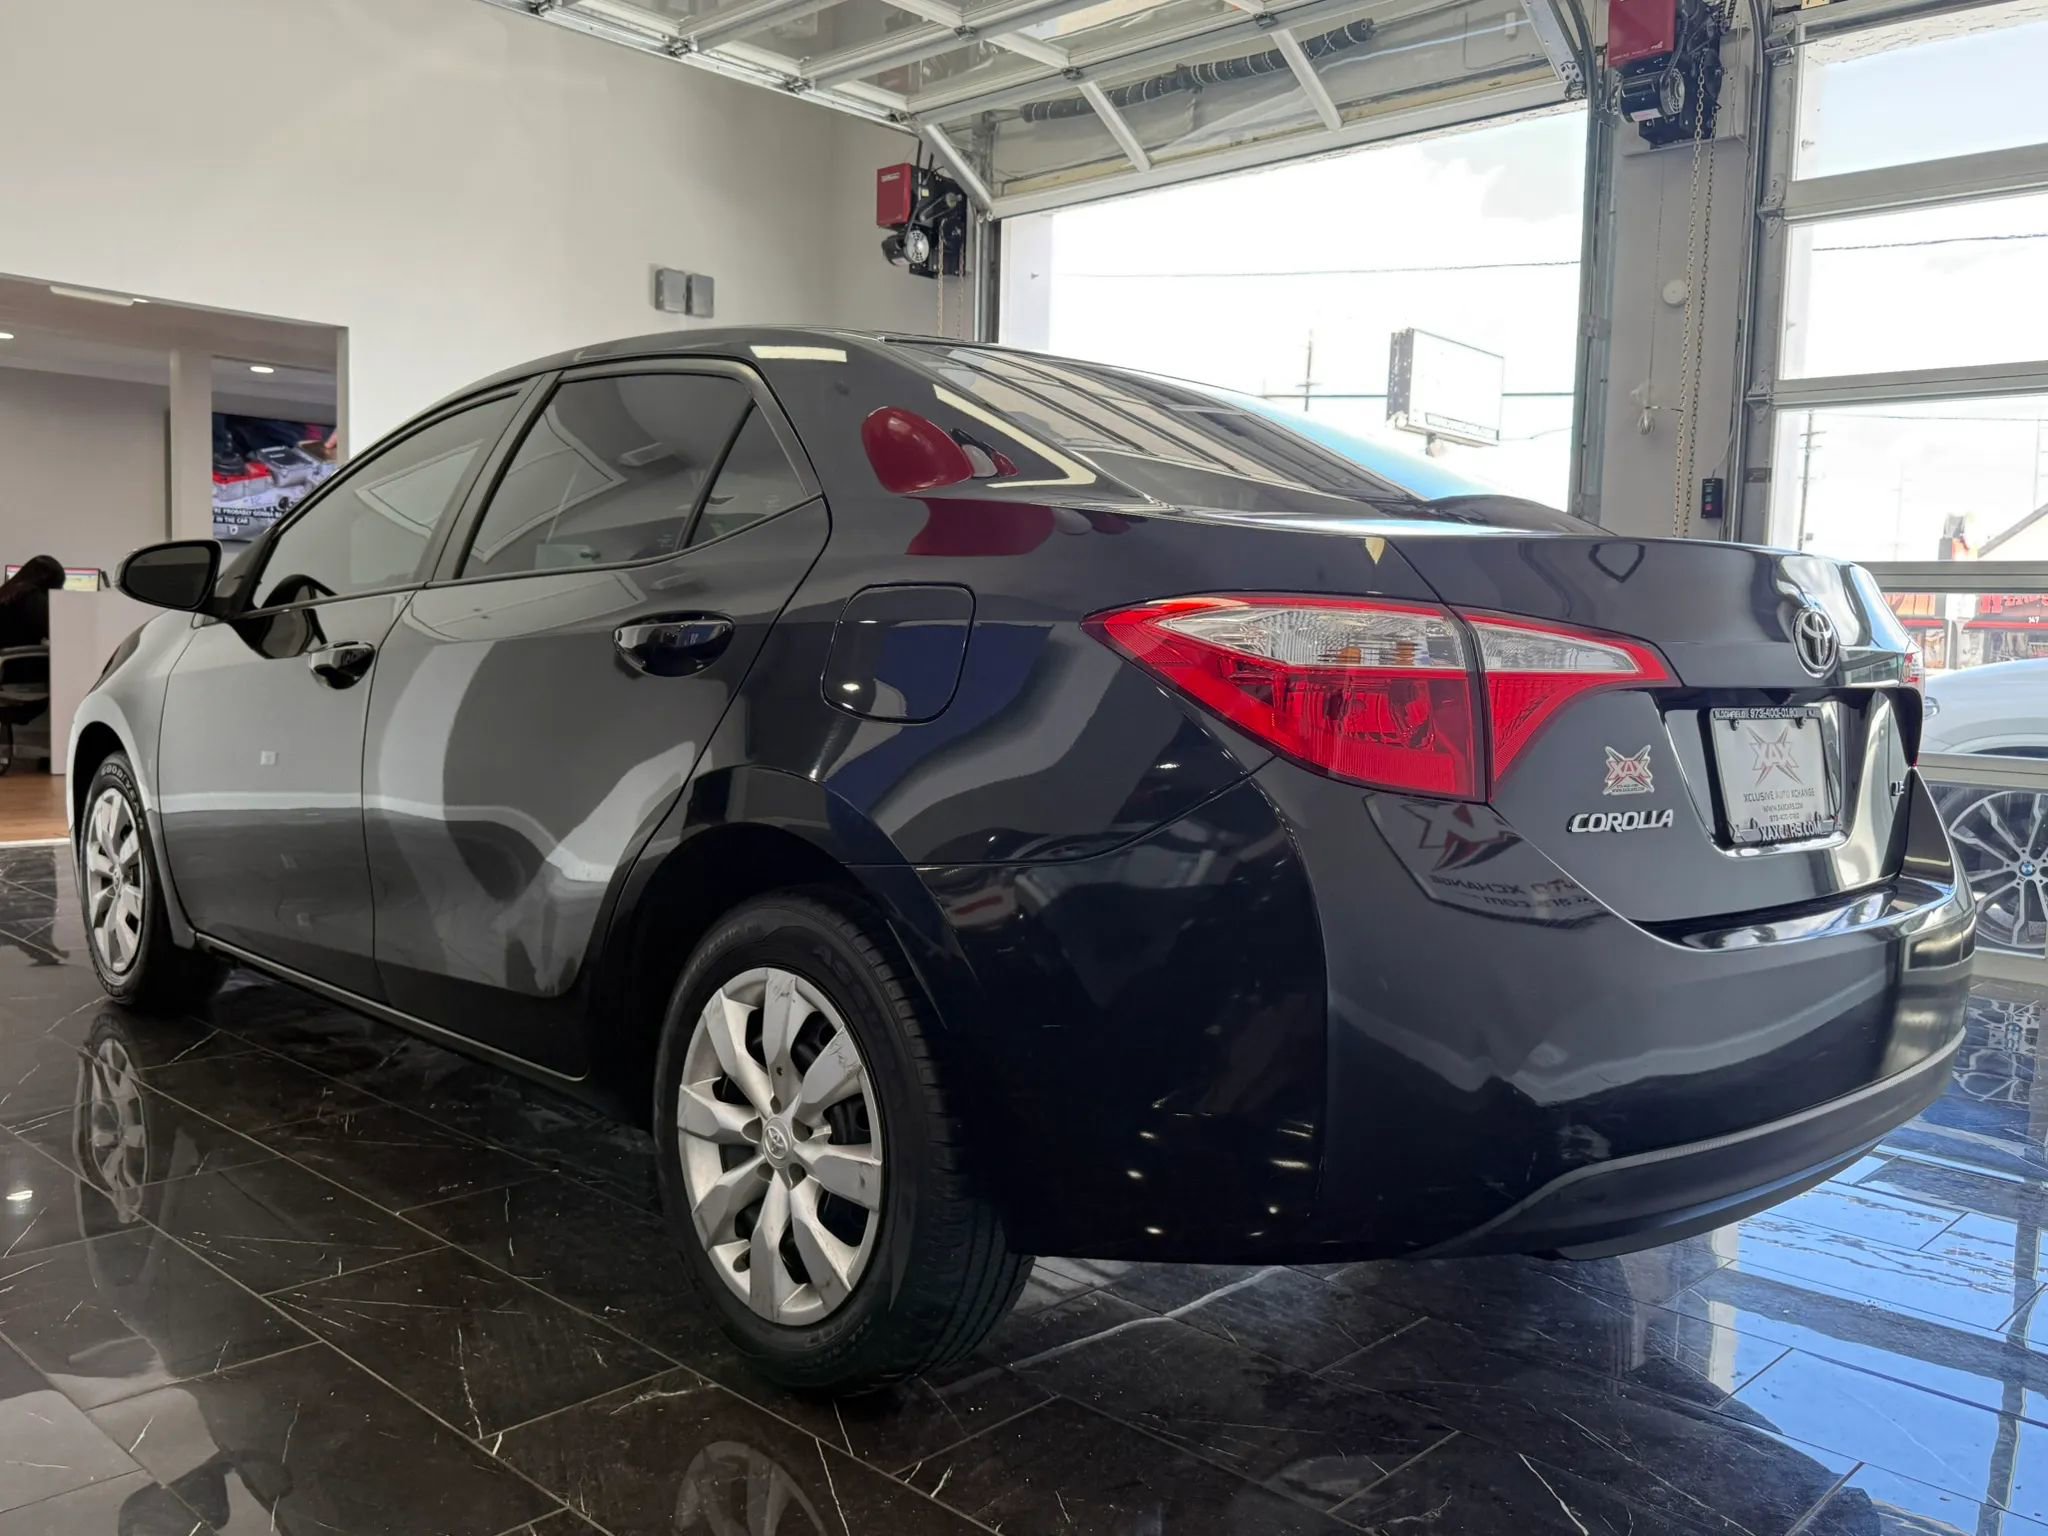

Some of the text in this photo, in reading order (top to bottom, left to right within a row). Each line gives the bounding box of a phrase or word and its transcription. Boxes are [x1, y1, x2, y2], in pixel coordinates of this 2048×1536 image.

[1743, 790, 1774, 803] XCLUSIVE
[1569, 808, 1674, 833] COROLLA
[1759, 820, 1822, 841] XAXCARS.COM
